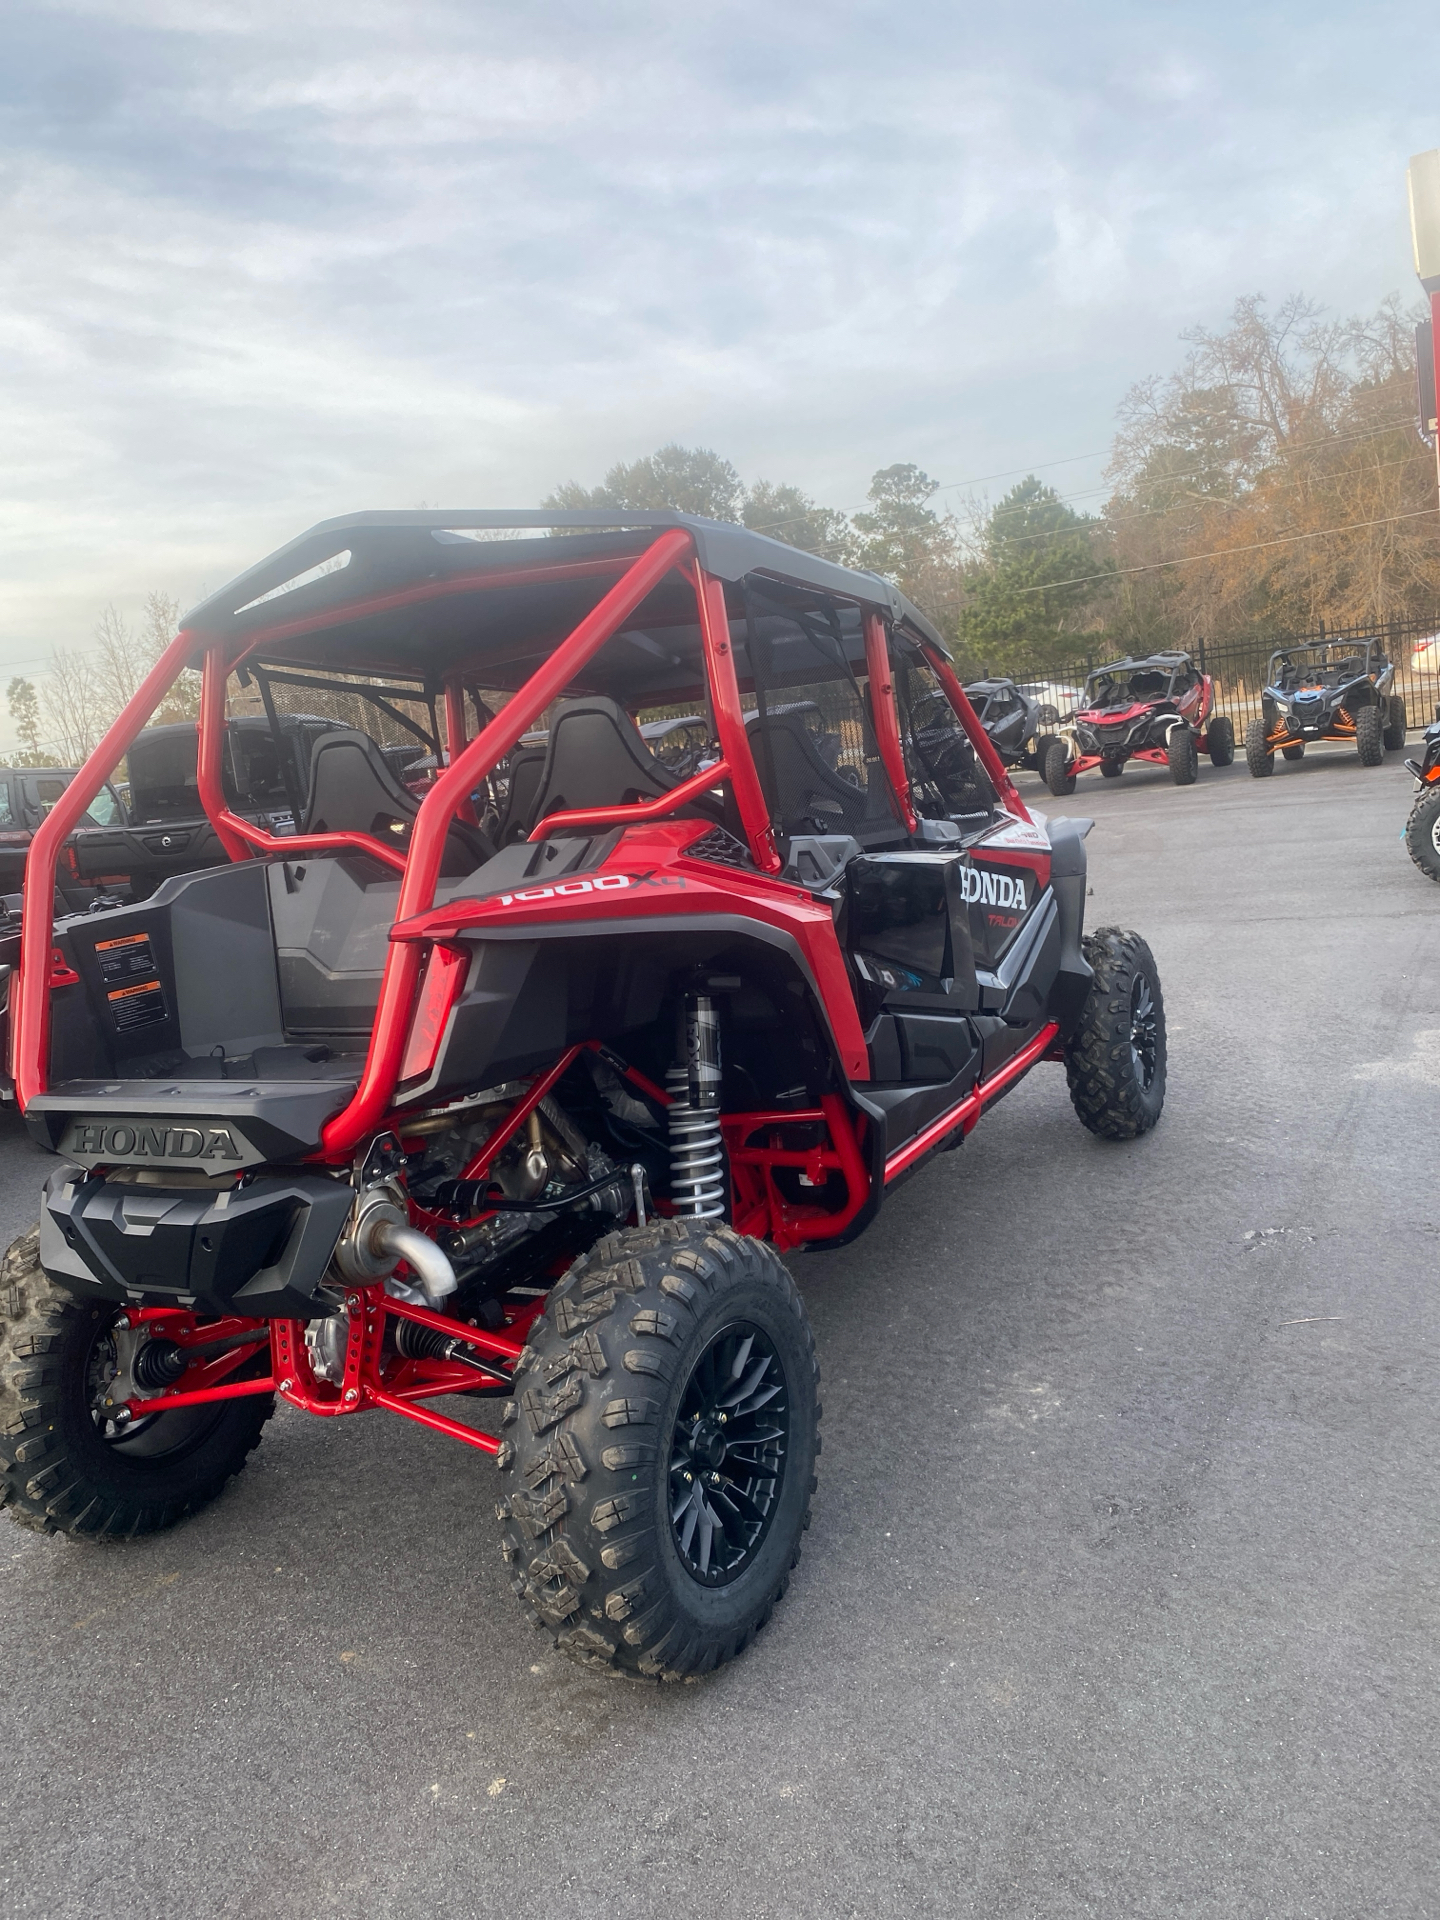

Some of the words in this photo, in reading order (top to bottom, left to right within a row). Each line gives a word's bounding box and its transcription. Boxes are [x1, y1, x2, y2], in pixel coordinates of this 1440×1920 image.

[960, 865, 1027, 910] HONDA
[113, 937, 136, 946] WARNING
[125, 985, 149, 994] WARNING
[73, 1125, 243, 1160] HONDA
